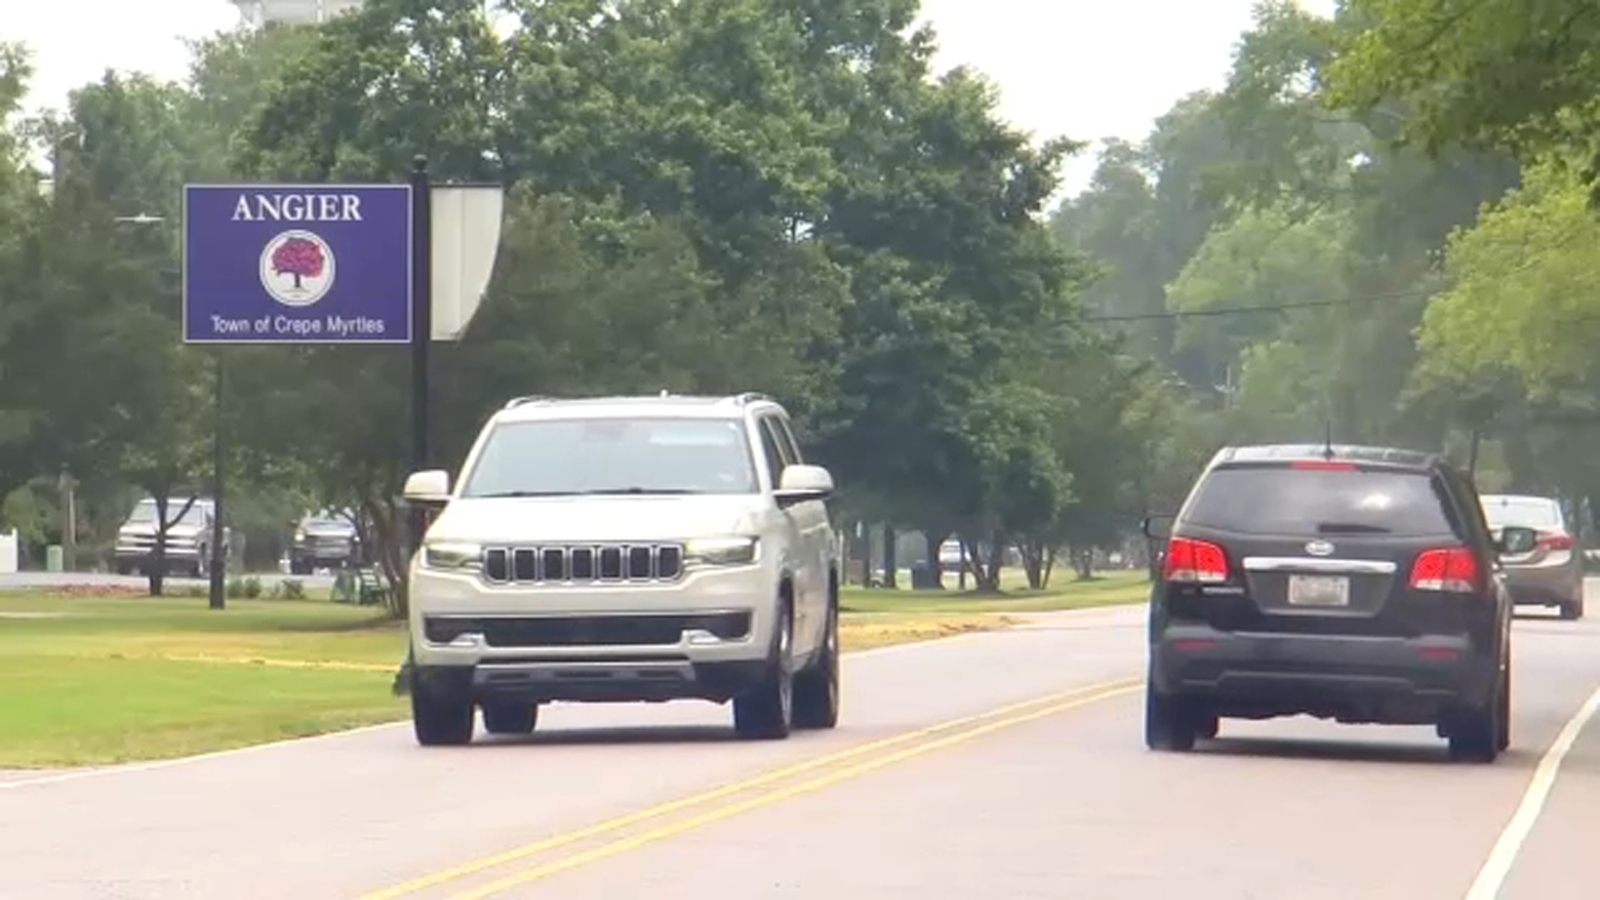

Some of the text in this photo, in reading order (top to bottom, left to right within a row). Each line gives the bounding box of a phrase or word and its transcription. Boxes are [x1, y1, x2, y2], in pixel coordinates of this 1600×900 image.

[231, 194, 363, 221] ANGIER
[211, 315, 385, 336] Town of Crepe Myrtles
